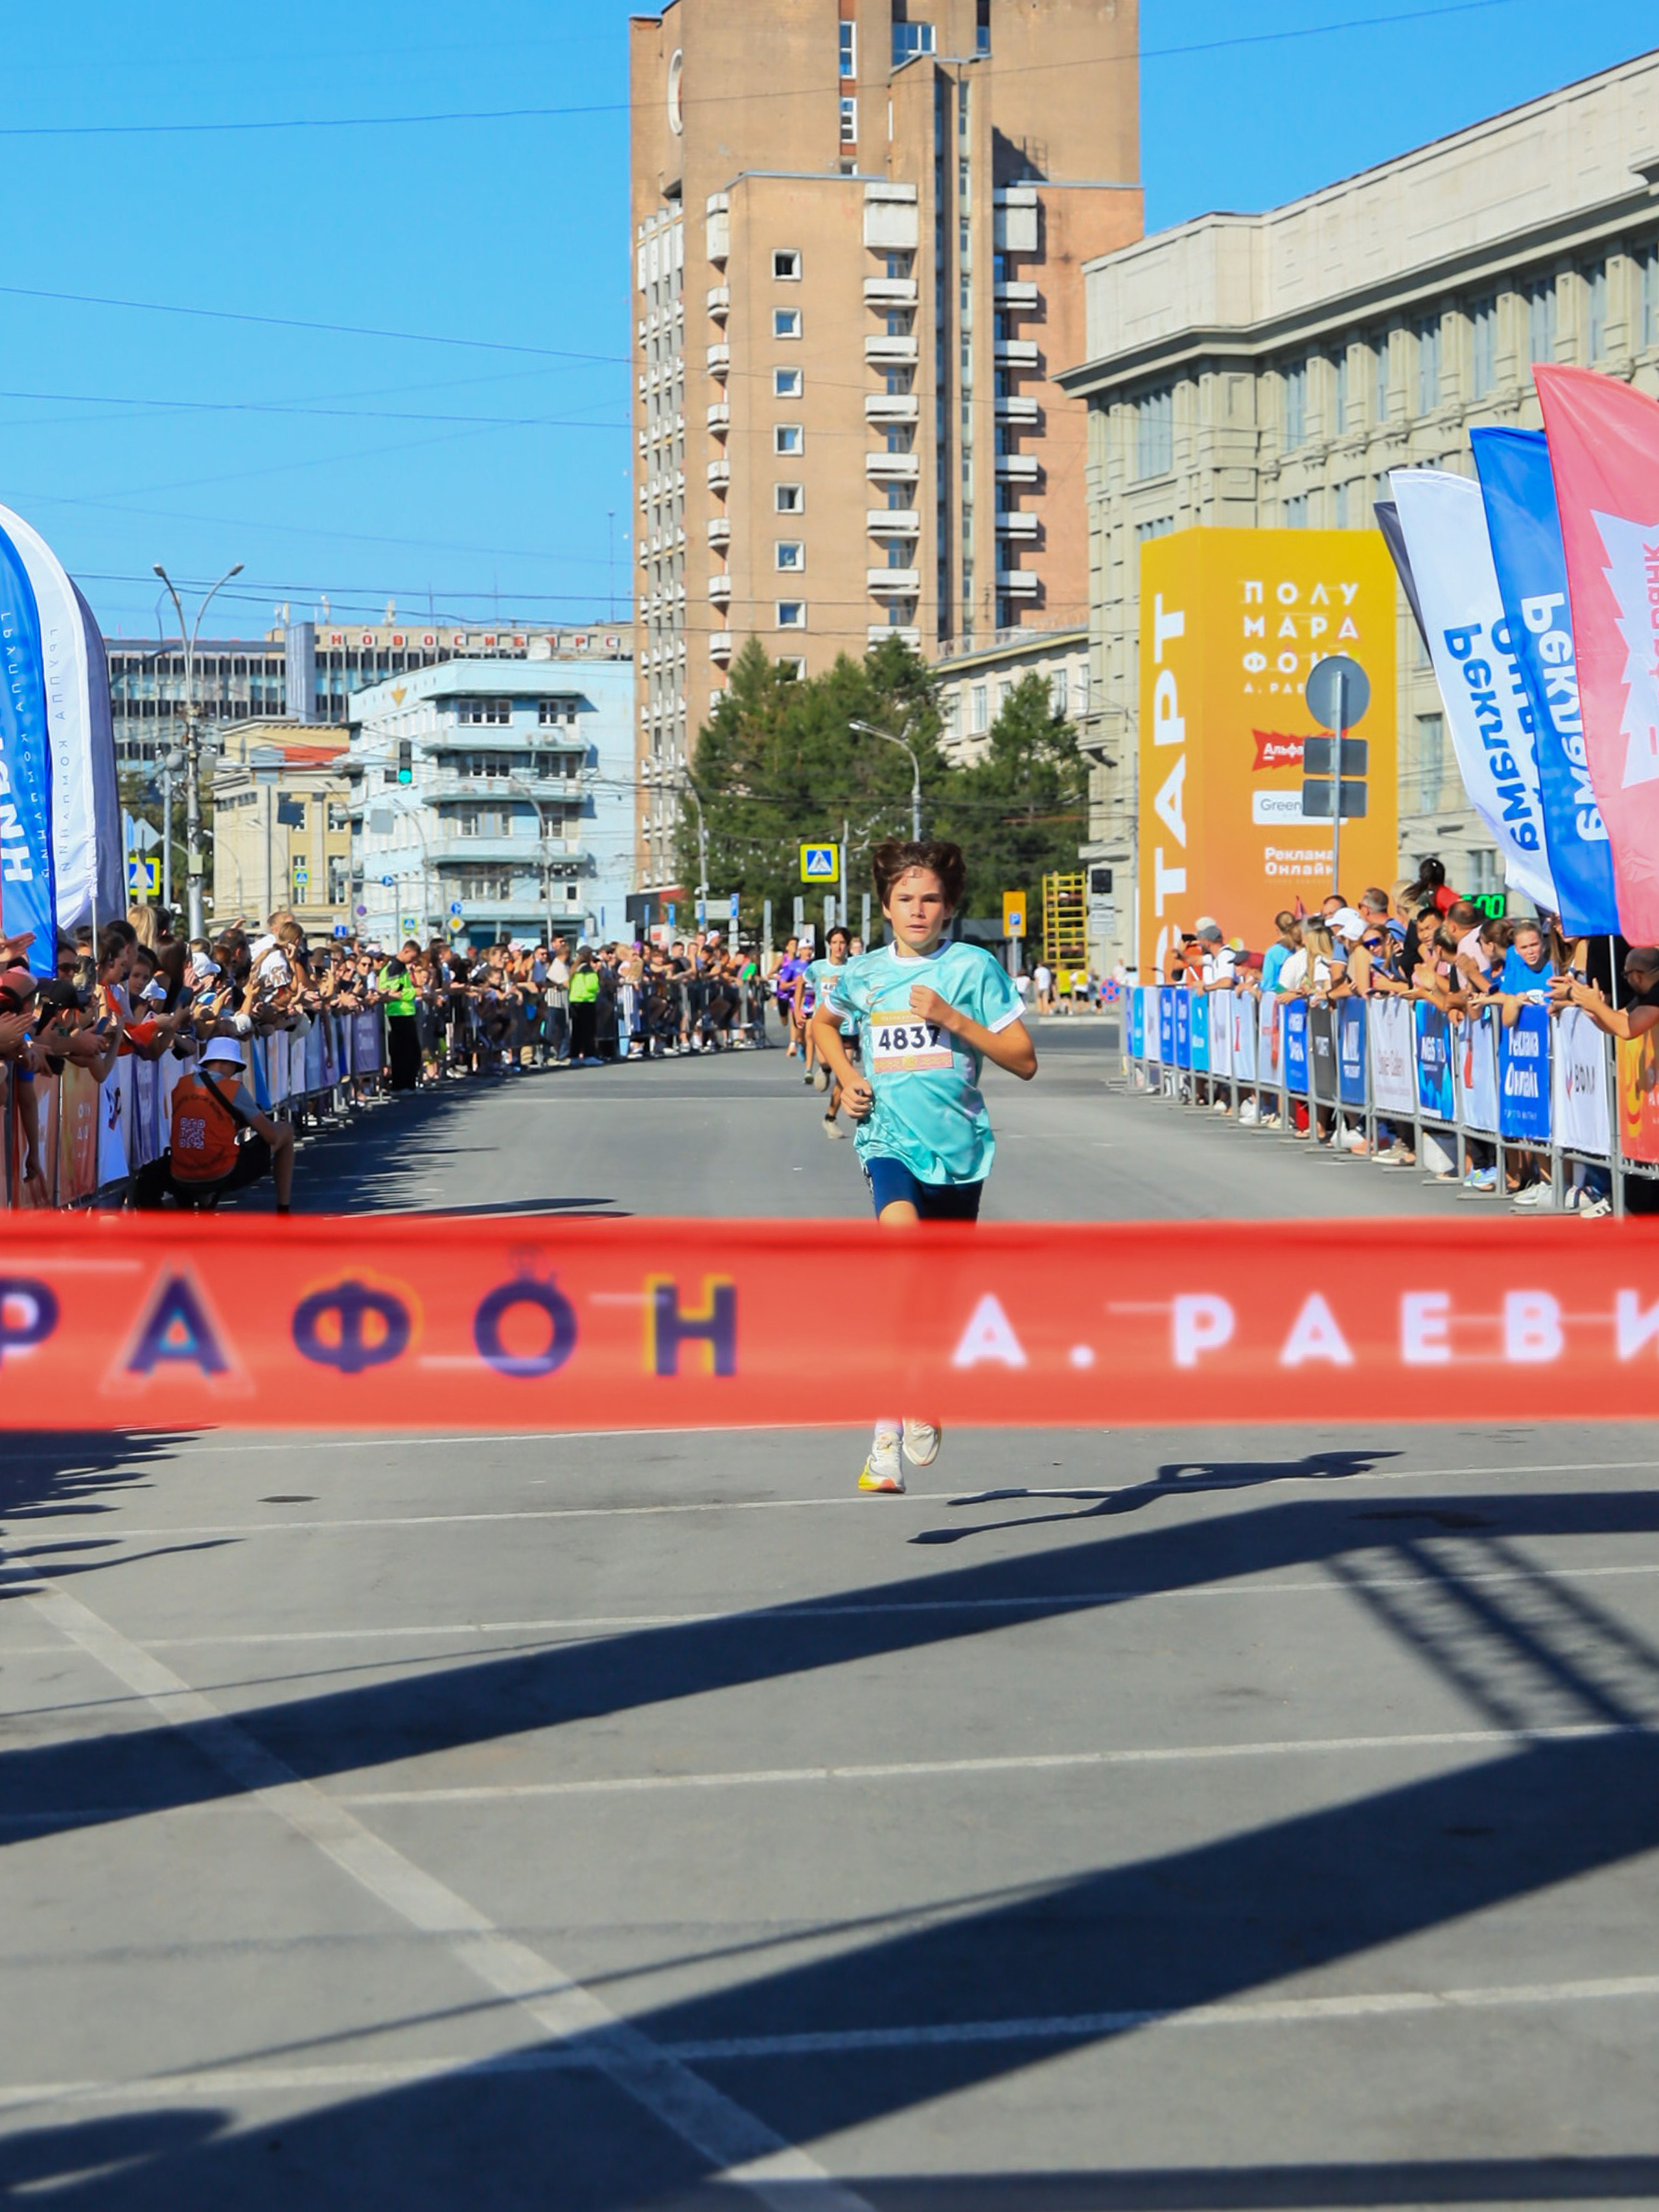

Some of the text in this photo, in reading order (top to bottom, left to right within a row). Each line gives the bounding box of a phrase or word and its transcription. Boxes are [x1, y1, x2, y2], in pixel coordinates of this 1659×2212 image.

[1244, 581, 1358, 605] ПОЛУ
[1244, 615, 1359, 639] МАРА
[1270, 682, 1306, 693] РАЕ
[1264, 846, 1335, 861] Реклама
[1264, 861, 1334, 876] Онлайн
[879, 1025, 941, 1051] 4837
[951, 1292, 1096, 1369] А.
